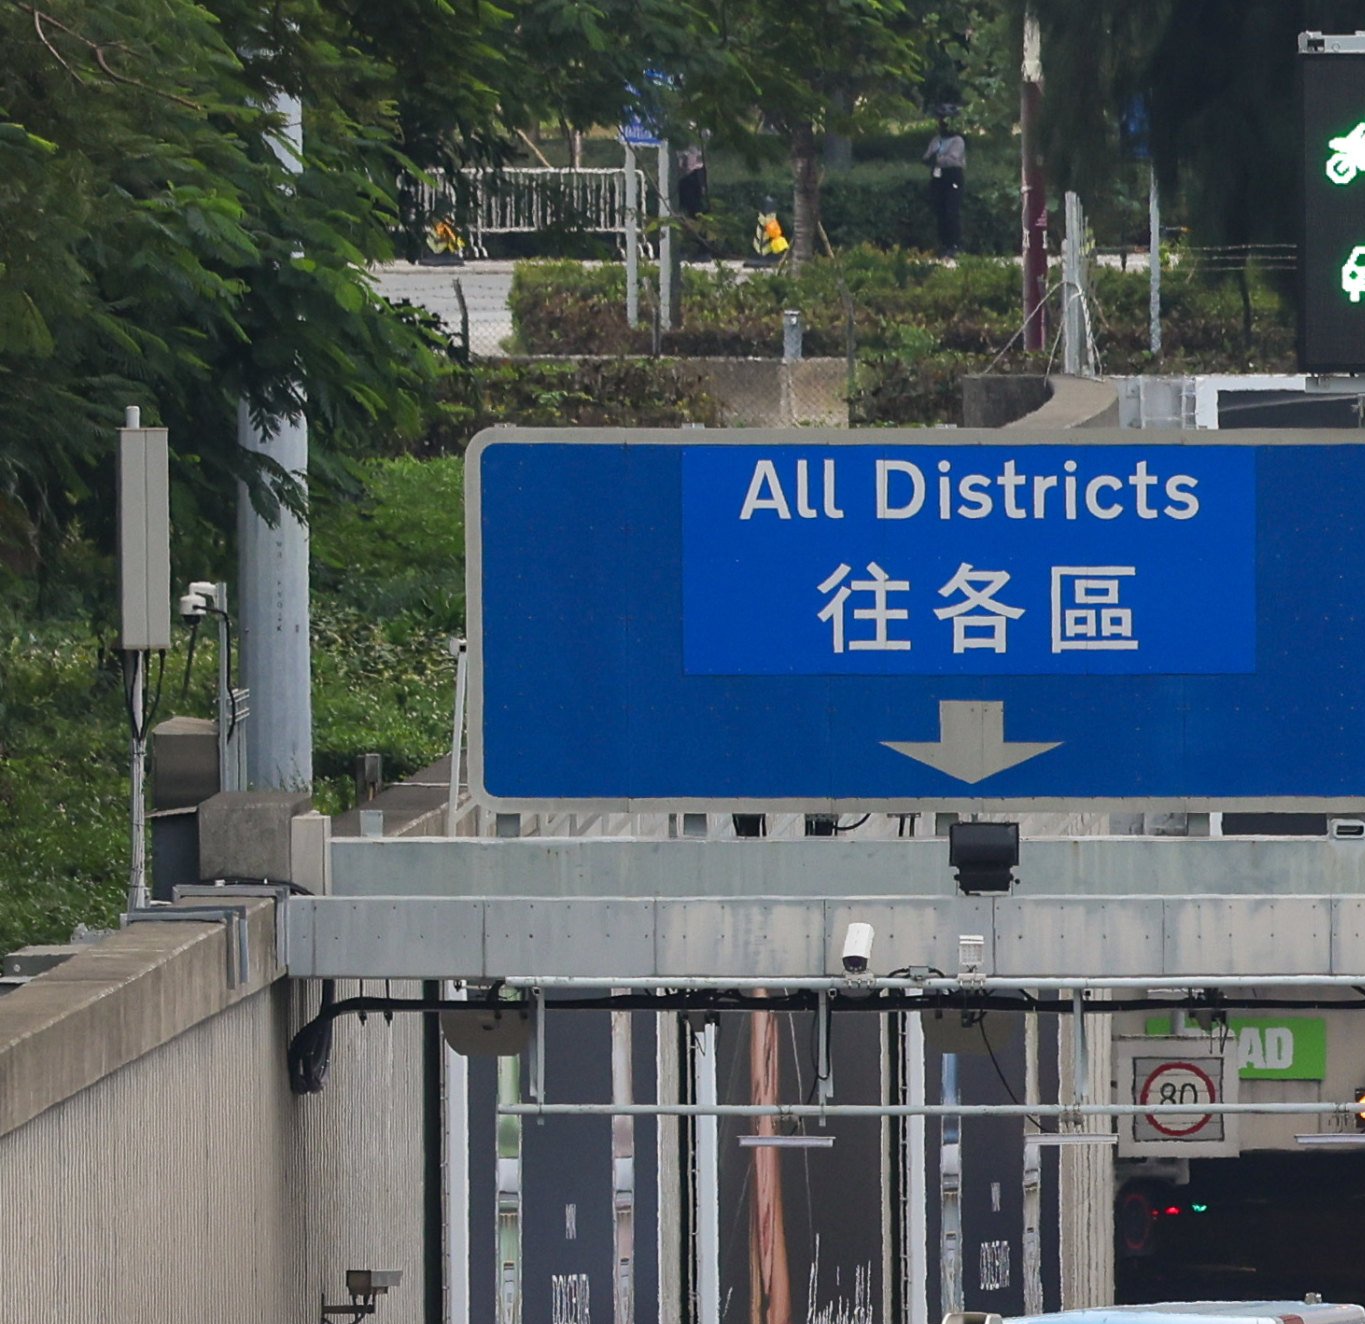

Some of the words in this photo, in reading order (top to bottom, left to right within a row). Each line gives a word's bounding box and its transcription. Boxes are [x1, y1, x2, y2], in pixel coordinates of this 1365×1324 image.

[738, 458, 844, 520] All
[876, 459, 1200, 521] Districts
[817, 561, 1139, 654] 往各區
[1159, 1082, 1198, 1110] 80
